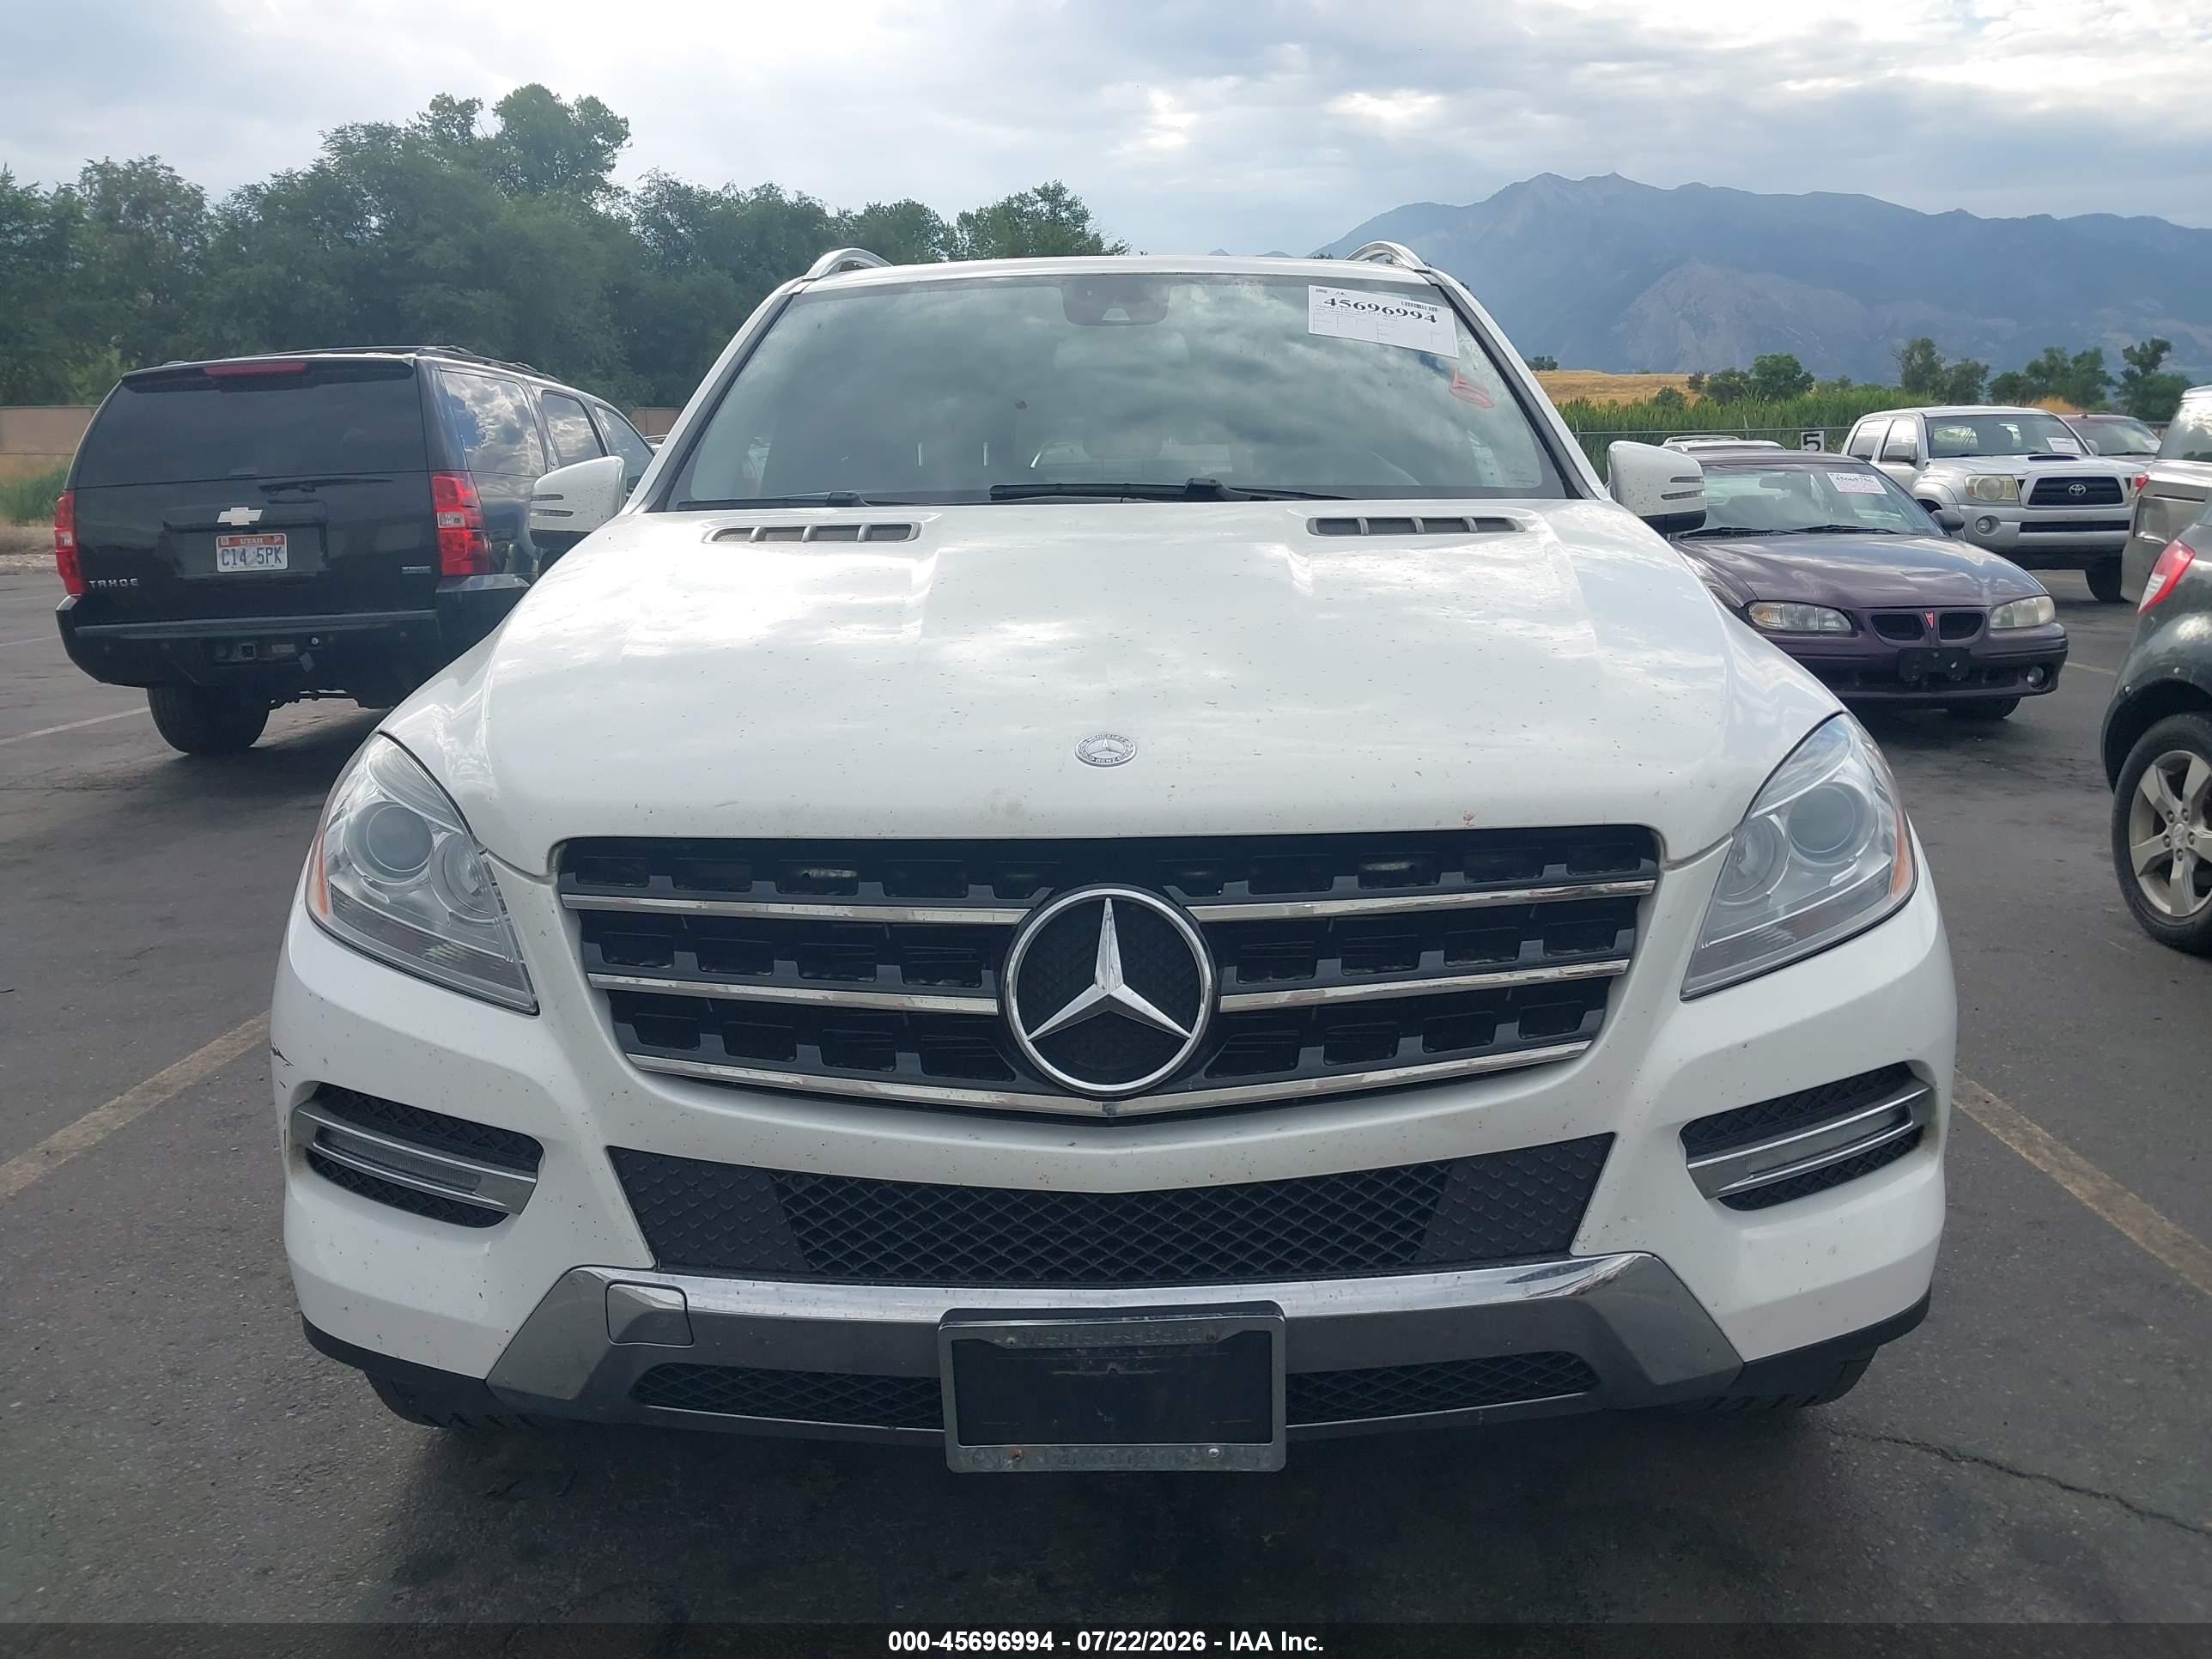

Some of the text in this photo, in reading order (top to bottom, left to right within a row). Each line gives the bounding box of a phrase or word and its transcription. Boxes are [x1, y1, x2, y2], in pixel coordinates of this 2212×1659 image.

[1323, 297, 1437, 324] 45696994
[1803, 433, 1820, 451] 5
[257, 546, 283, 565] 5PK
[88, 578, 138, 588] TAHOE
